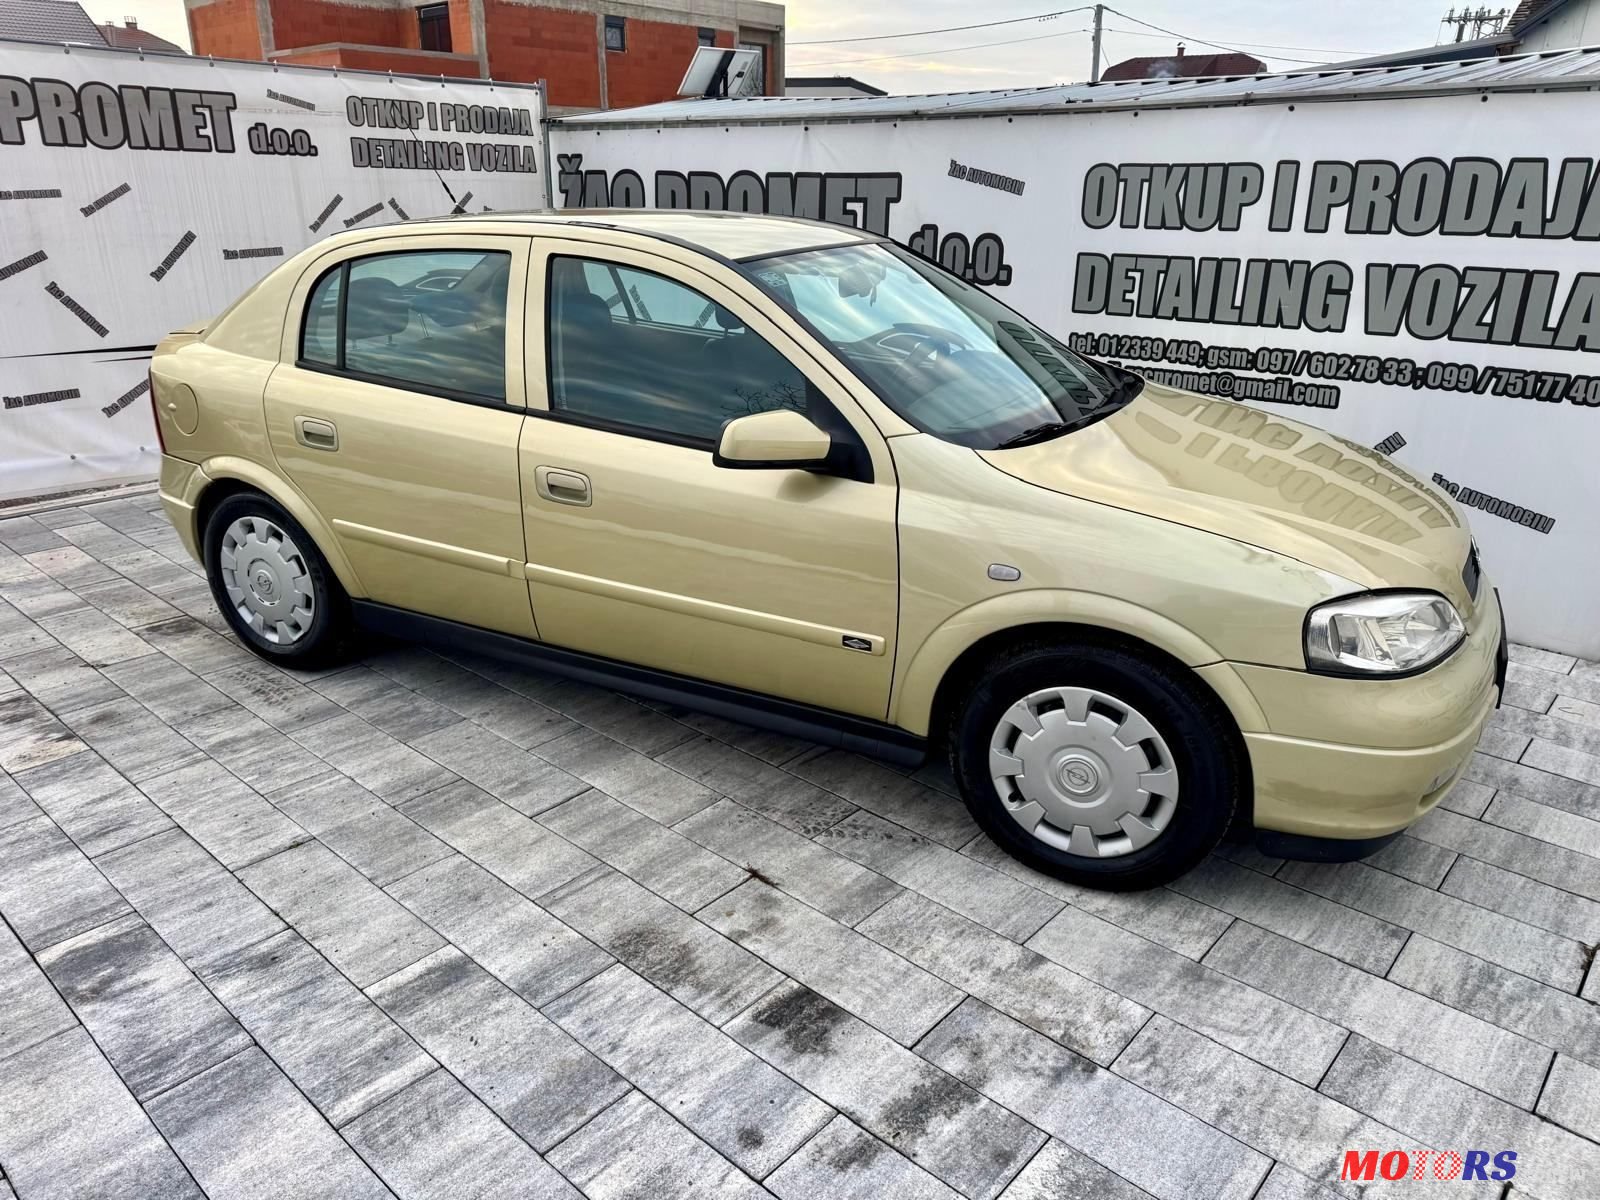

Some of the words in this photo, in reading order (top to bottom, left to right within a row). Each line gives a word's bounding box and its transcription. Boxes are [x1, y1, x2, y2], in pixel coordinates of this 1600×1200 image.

[0, 75, 237, 153] PROMET
[248, 123, 318, 157] d.o.o.
[346, 96, 424, 129] OTKUP
[427, 102, 438, 131] I
[439, 103, 534, 136] PRODAJA
[350, 137, 465, 171] DETAILING
[466, 143, 537, 173] VOZILA
[948, 159, 967, 179] ŽAC
[965, 167, 1026, 196] AUTOMOBILI
[1081, 162, 1264, 232] OTKUP
[1268, 160, 1300, 232] I
[60, 296, 109, 338] AUTOMOBILI
[1071, 252, 1353, 333] DETAILING
[1364, 263, 1600, 351] VOZILA
[1069, 332, 1097, 356] tel:
[1205, 345, 1255, 371] gsm:
[1256, 347, 1297, 375] 097
[1307, 351, 1351, 380] 602
[1351, 355, 1383, 383] 78
[1425, 361, 1478, 393] 099
[1491, 367, 1538, 399] 751
[1535, 371, 1572, 403] 77
[23, 388, 81, 406] AUTOMOBILI
[1455, 487, 1556, 535] AUTOMOBILI
